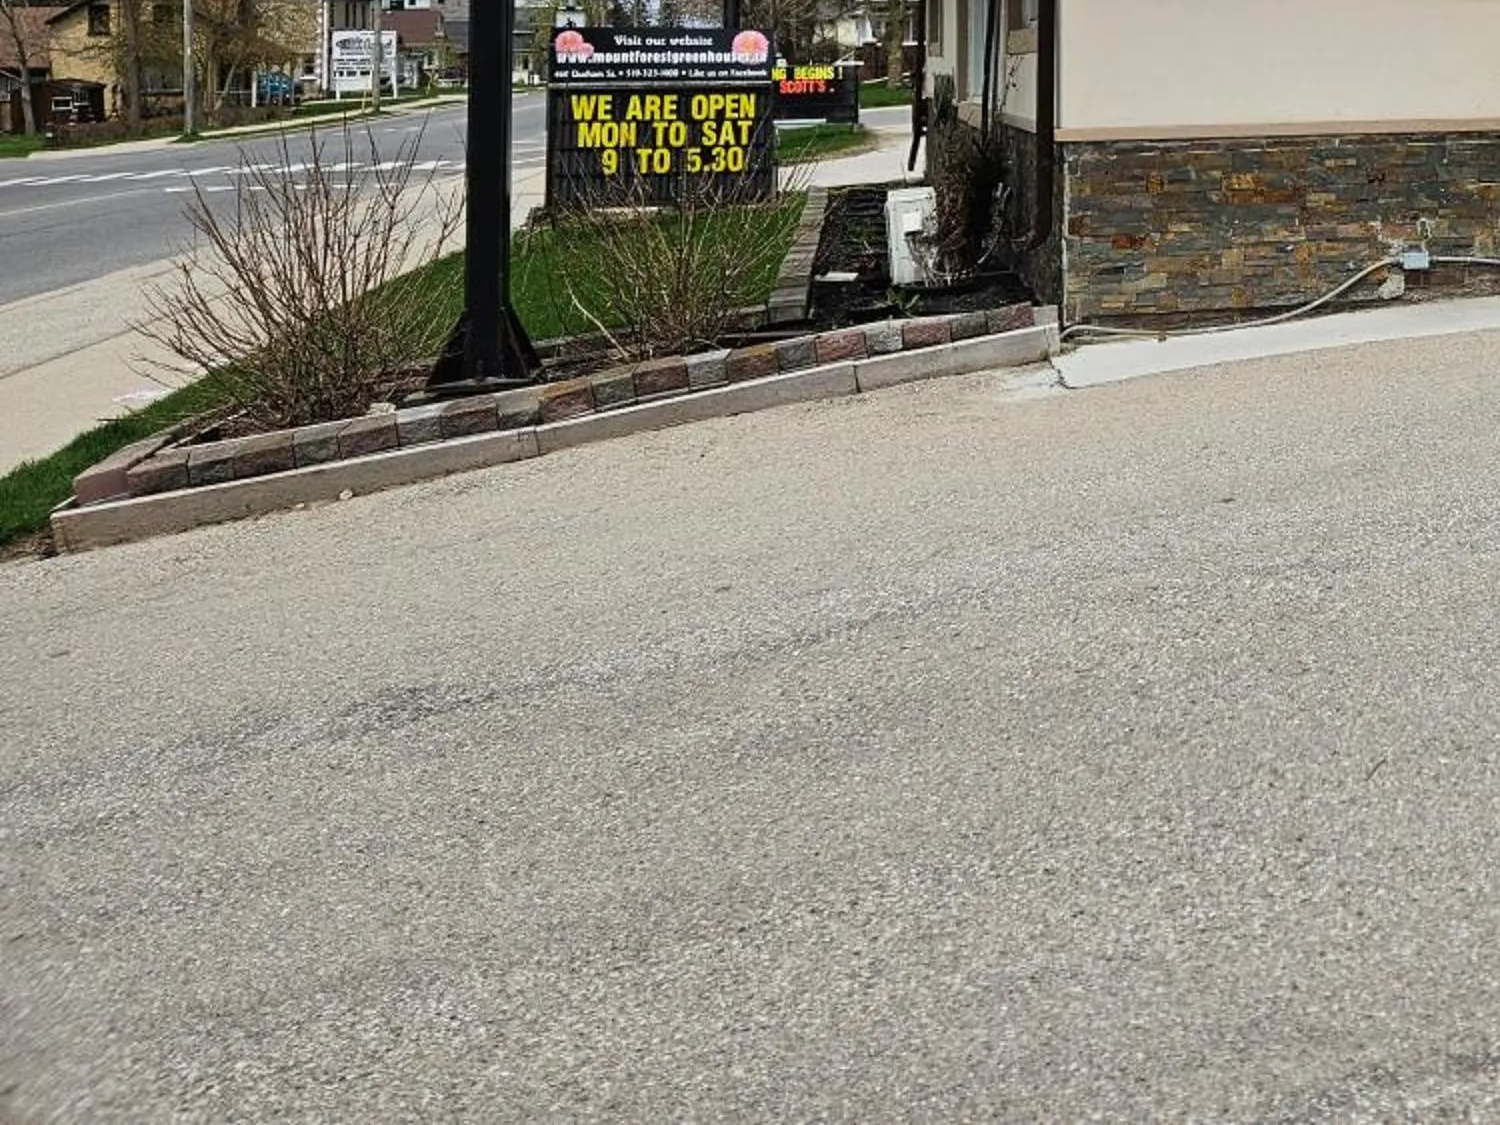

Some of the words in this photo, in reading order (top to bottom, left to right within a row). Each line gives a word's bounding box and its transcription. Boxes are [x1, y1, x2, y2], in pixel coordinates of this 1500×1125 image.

[613, 34, 643, 46] Visit
[645, 37, 666, 46] our
[669, 35, 713, 46] website
[571, 94, 613, 120] WE
[626, 94, 678, 120] ARE
[691, 93, 756, 120] OPEN
[577, 121, 637, 148] MON
[653, 121, 686, 147] TO
[701, 120, 753, 146] SAT
[602, 148, 618, 174] 9
[636, 148, 670, 174] TO
[687, 146, 743, 173] 5.30
